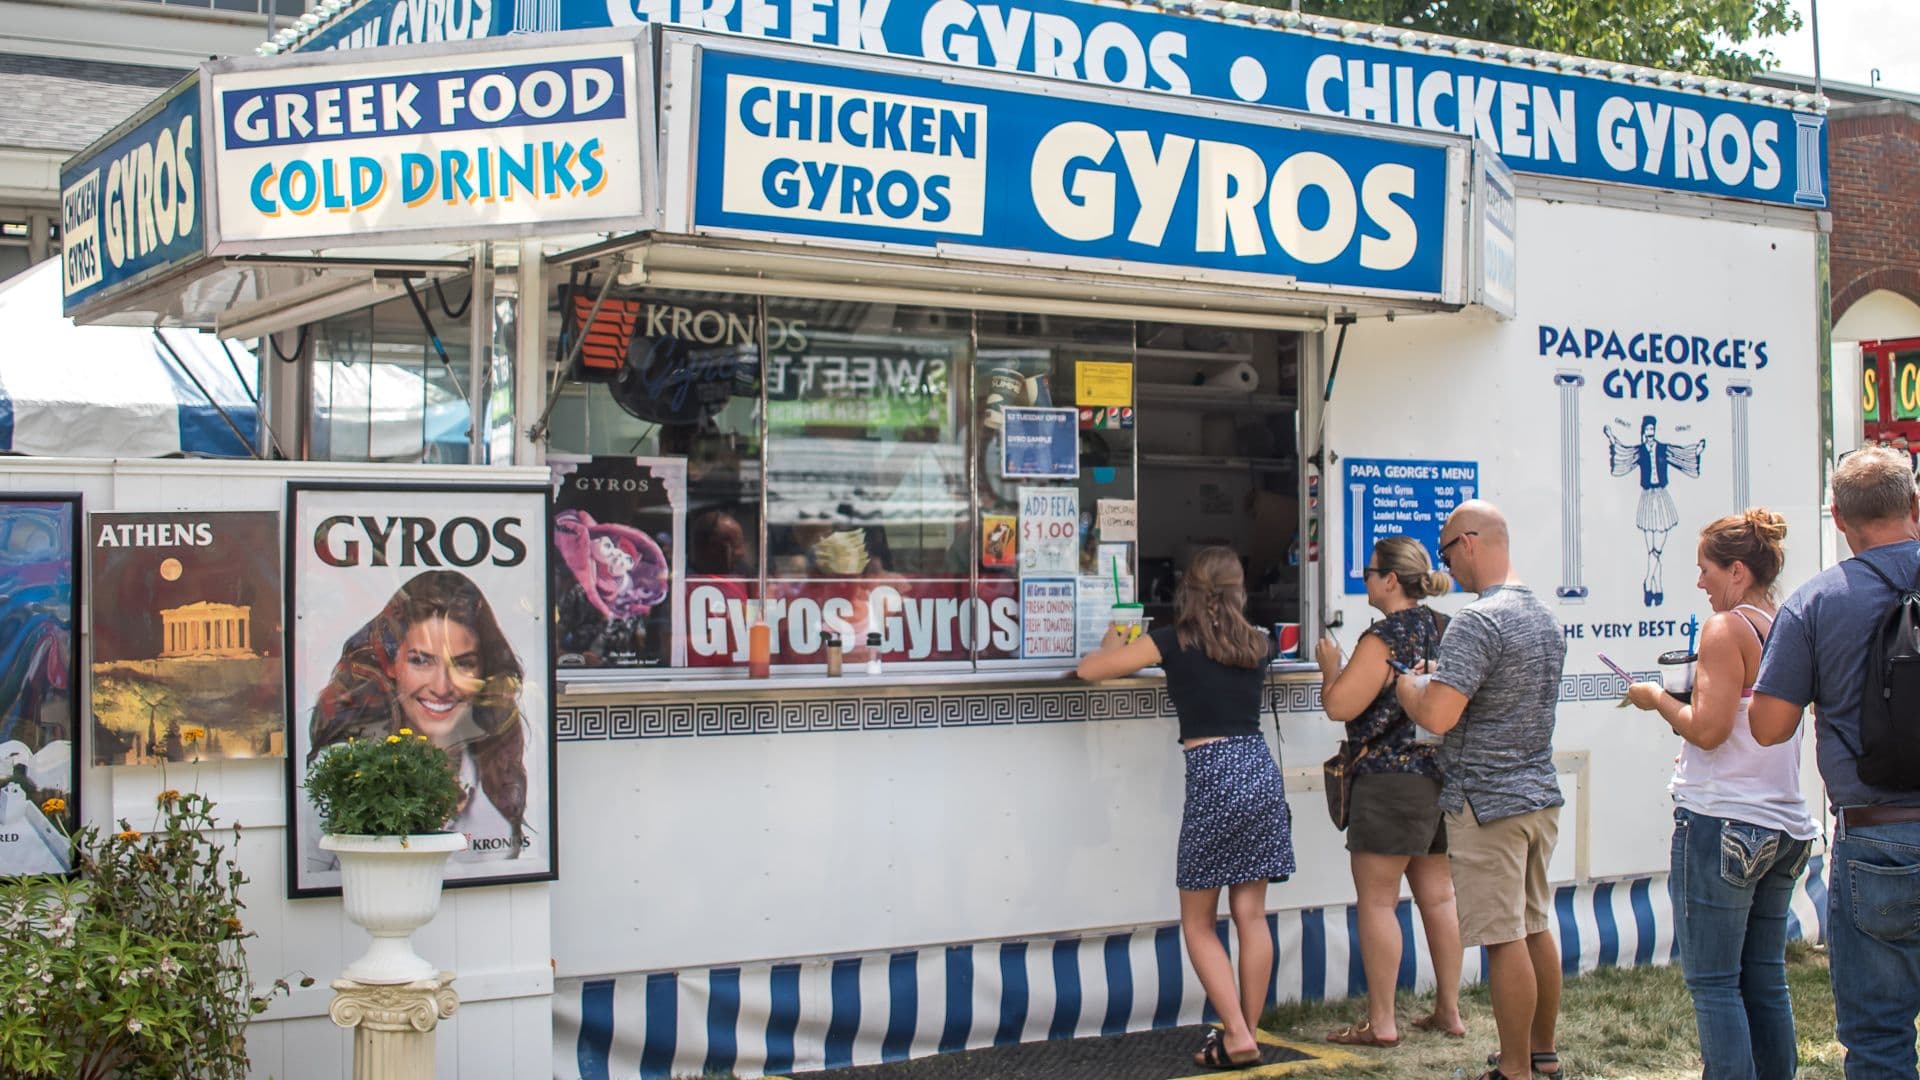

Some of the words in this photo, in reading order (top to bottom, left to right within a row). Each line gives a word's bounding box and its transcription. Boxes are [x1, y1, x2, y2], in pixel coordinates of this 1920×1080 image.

[234, 82, 422, 142] GREEK
[437, 68, 616, 127] FOOD
[921, 0, 1191, 95] GYROS
[1306, 54, 1577, 164] CHICKEN
[1598, 96, 1781, 190] GYROS
[739, 86, 977, 159] CHICKEN
[105, 115, 195, 269] GYROS
[250, 154, 387, 217] COLD
[401, 138, 608, 209] DRINKS
[762, 158, 951, 223] GYROS
[1031, 121, 1418, 271] GYROS
[65, 176, 98, 234] CHICKEN
[69, 235, 95, 287] GYROS
[645, 303, 807, 352] KRONOS
[1538, 325, 1769, 370] PAPAGEORGE'S
[1602, 368, 1710, 403] GYROS
[576, 477, 650, 492] GYROS
[1351, 464, 1381, 477] PAPA
[1385, 466, 1439, 479] GEORGE'S
[1442, 467, 1475, 480] MENU
[1373, 485, 1393, 495] Greek
[1394, 485, 1414, 496] Gyros
[1024, 496, 1048, 516] ADD
[1051, 496, 1076, 517] FETA
[1373, 497, 1398, 508] Chicken
[1399, 498, 1419, 509] Gyros
[1373, 511, 1395, 520] Loaded
[1413, 511, 1432, 521] Gyros
[97, 522, 213, 548] ATHENS
[313, 515, 528, 568] GYROS
[1373, 524, 1388, 533] Add
[1388, 524, 1403, 533] Feta
[690, 585, 856, 662] Gyros
[869, 585, 1020, 660] Gyros
[1564, 624, 1584, 639] HE
[1592, 623, 1633, 638] VERY
[1639, 621, 1676, 637] BEST
[473, 837, 531, 851] KRONOS
